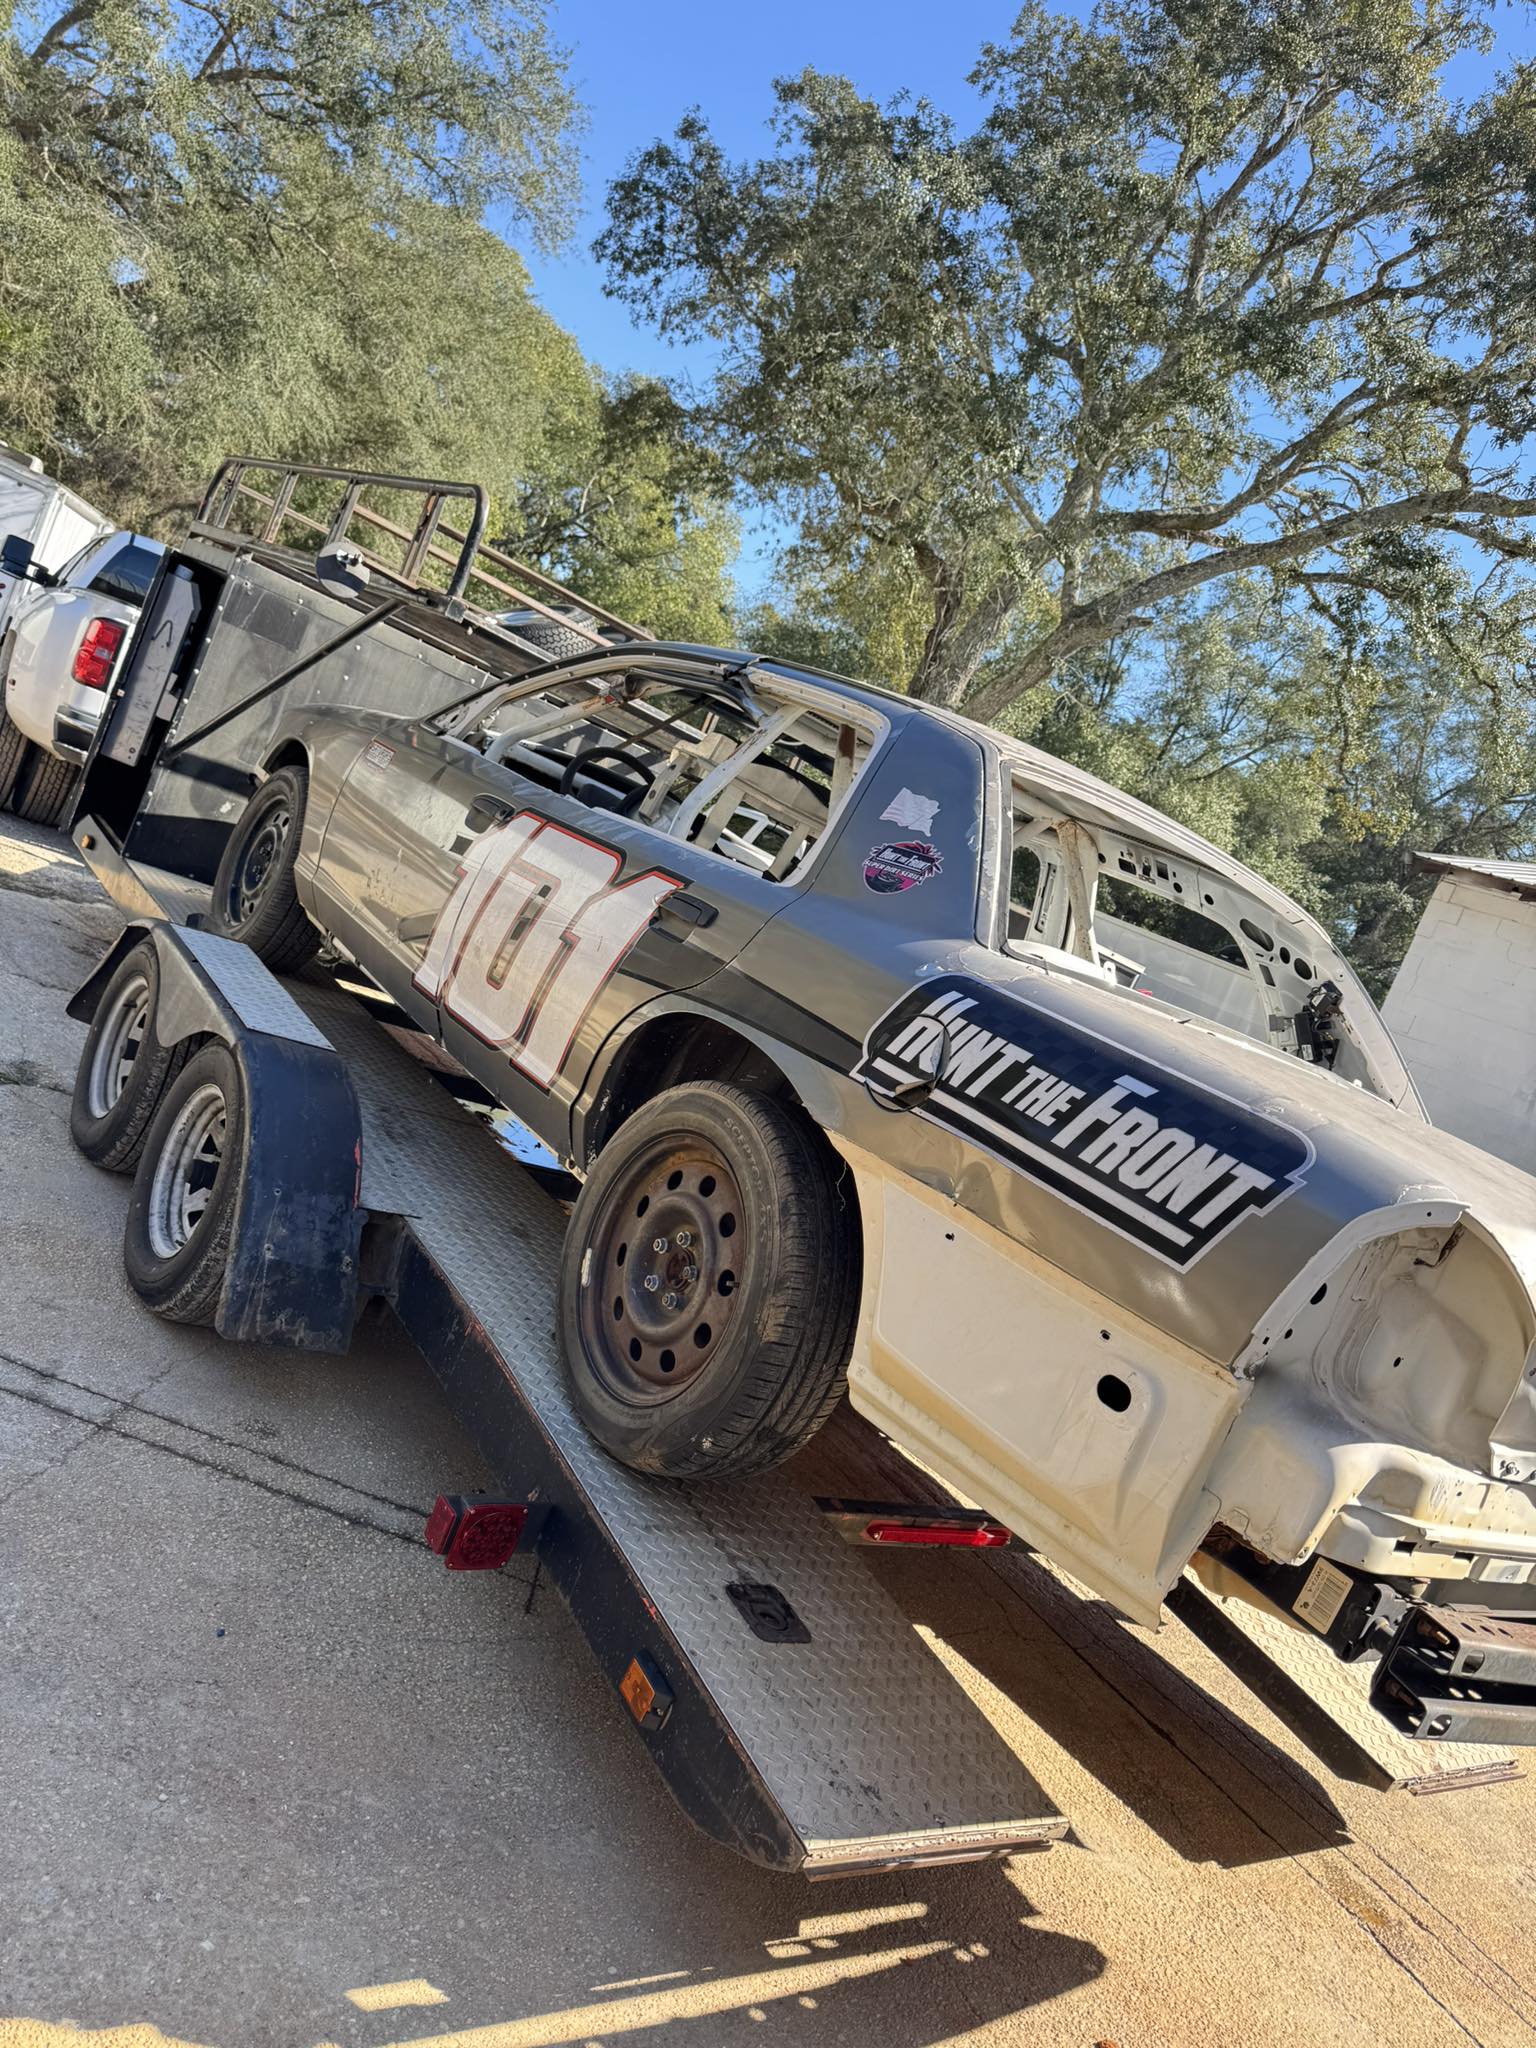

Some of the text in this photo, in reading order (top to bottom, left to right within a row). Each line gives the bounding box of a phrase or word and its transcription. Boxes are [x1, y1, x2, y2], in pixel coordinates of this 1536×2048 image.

[411, 807, 692, 1096] 101
[864, 859, 922, 881] SUPER DIRT SERIES
[885, 990, 1276, 1230] HUNT THE FRONT
